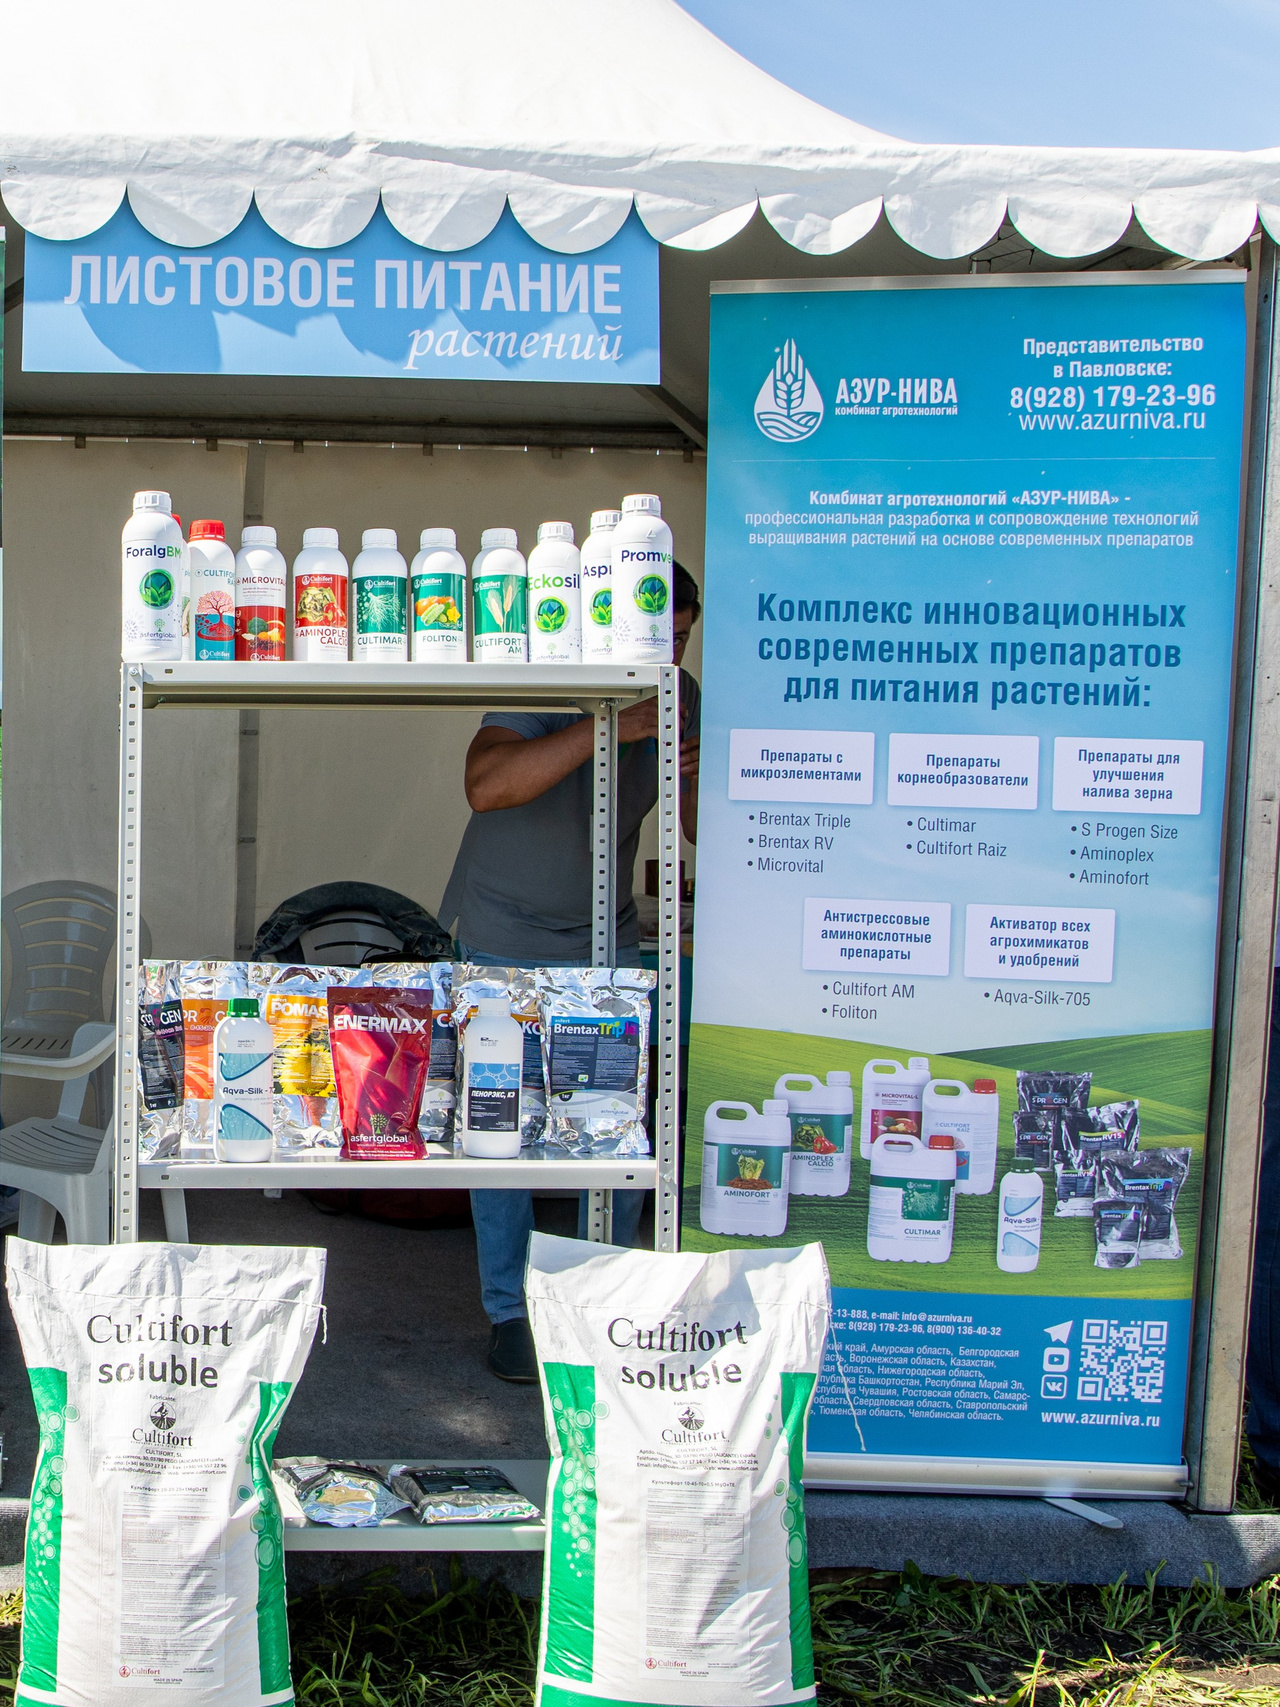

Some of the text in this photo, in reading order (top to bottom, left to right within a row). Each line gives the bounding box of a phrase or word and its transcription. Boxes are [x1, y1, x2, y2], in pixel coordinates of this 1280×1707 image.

[63, 254, 622, 313] ЛИСТОВОЕ ПИТАНИЕ
[403, 322, 623, 370] растений
[1023, 337, 1203, 358] Представительство
[1053, 361, 1172, 377] в Павловске:
[835, 378, 958, 404] АЗУР-НИВА
[1010, 384, 1215, 412] 8(928) 179-23-96
[835, 404, 958, 418] комбинат агротехнологий
[1019, 406, 1206, 432] www.azurniva.ru
[810, 490, 1119, 509] Комбинат агротехнологий «АЗУР-НИВА»
[745, 510, 883, 527] профессиональная
[749, 533, 1193, 549] выращивания препаратов
[528, 573, 580, 590] Eckosil
[758, 593, 1186, 629] Комплекс инновационных
[358, 636, 402, 644] CULTIMAR
[475, 637, 521, 647] CULTIFORT
[508, 645, 521, 653] AM
[759, 638, 1181, 673] современных препаратов
[784, 676, 1150, 710] для питания растений:
[761, 749, 843, 765] Препараты с
[926, 754, 1000, 770] Препараты
[1078, 749, 1152, 765] Препараты
[741, 768, 861, 781] микроэлементами
[898, 771, 1028, 787] корнеобразователи
[759, 811, 851, 830] Brentax Triple
[918, 817, 977, 832] Cultimar
[1082, 822, 1178, 841] S Progen Size
[759, 834, 834, 850] Brentax RV
[917, 840, 1007, 857] Cultifort Raiz
[1080, 846, 1154, 864] Aminoplex
[758, 857, 823, 873] Microvital
[1079, 869, 1149, 885] Aminofort
[824, 909, 930, 926] Антистрессовые
[990, 916, 1057, 933] Активатор
[990, 936, 1089, 950] агрохимикатов
[840, 948, 910, 961] препараты
[1010, 953, 1079, 968] удобрений
[833, 981, 914, 998] Cultifort AM
[994, 989, 1090, 1006] Aqva-Silk-705
[832, 1004, 877, 1020] Foliton
[334, 1013, 427, 1033] ENERMAX
[554, 1020, 637, 1037] Brentax Triple
[223, 1086, 263, 1094] Aqva-Silk
[350, 1134, 408, 1143] asfertglobal
[724, 1190, 770, 1198] AMINOFORT
[871, 1311, 972, 1323] e-mail: info@azurniva.ru
[86, 1312, 233, 1347] Cultifort
[608, 1316, 748, 1352] Cultifort
[848, 1321, 877, 1330] 8(928)
[927, 1324, 955, 1334] 8(900)
[957, 1326, 1001, 1336] 136-40-32
[959, 1346, 1019, 1358] Белгородская
[98, 1353, 219, 1387] soluble
[621, 1359, 743, 1391] soluble
[1041, 1412, 1160, 1427] www.azurniva.ru
[132, 1427, 193, 1445] Cultifort
[662, 1428, 726, 1442] Cultifort
